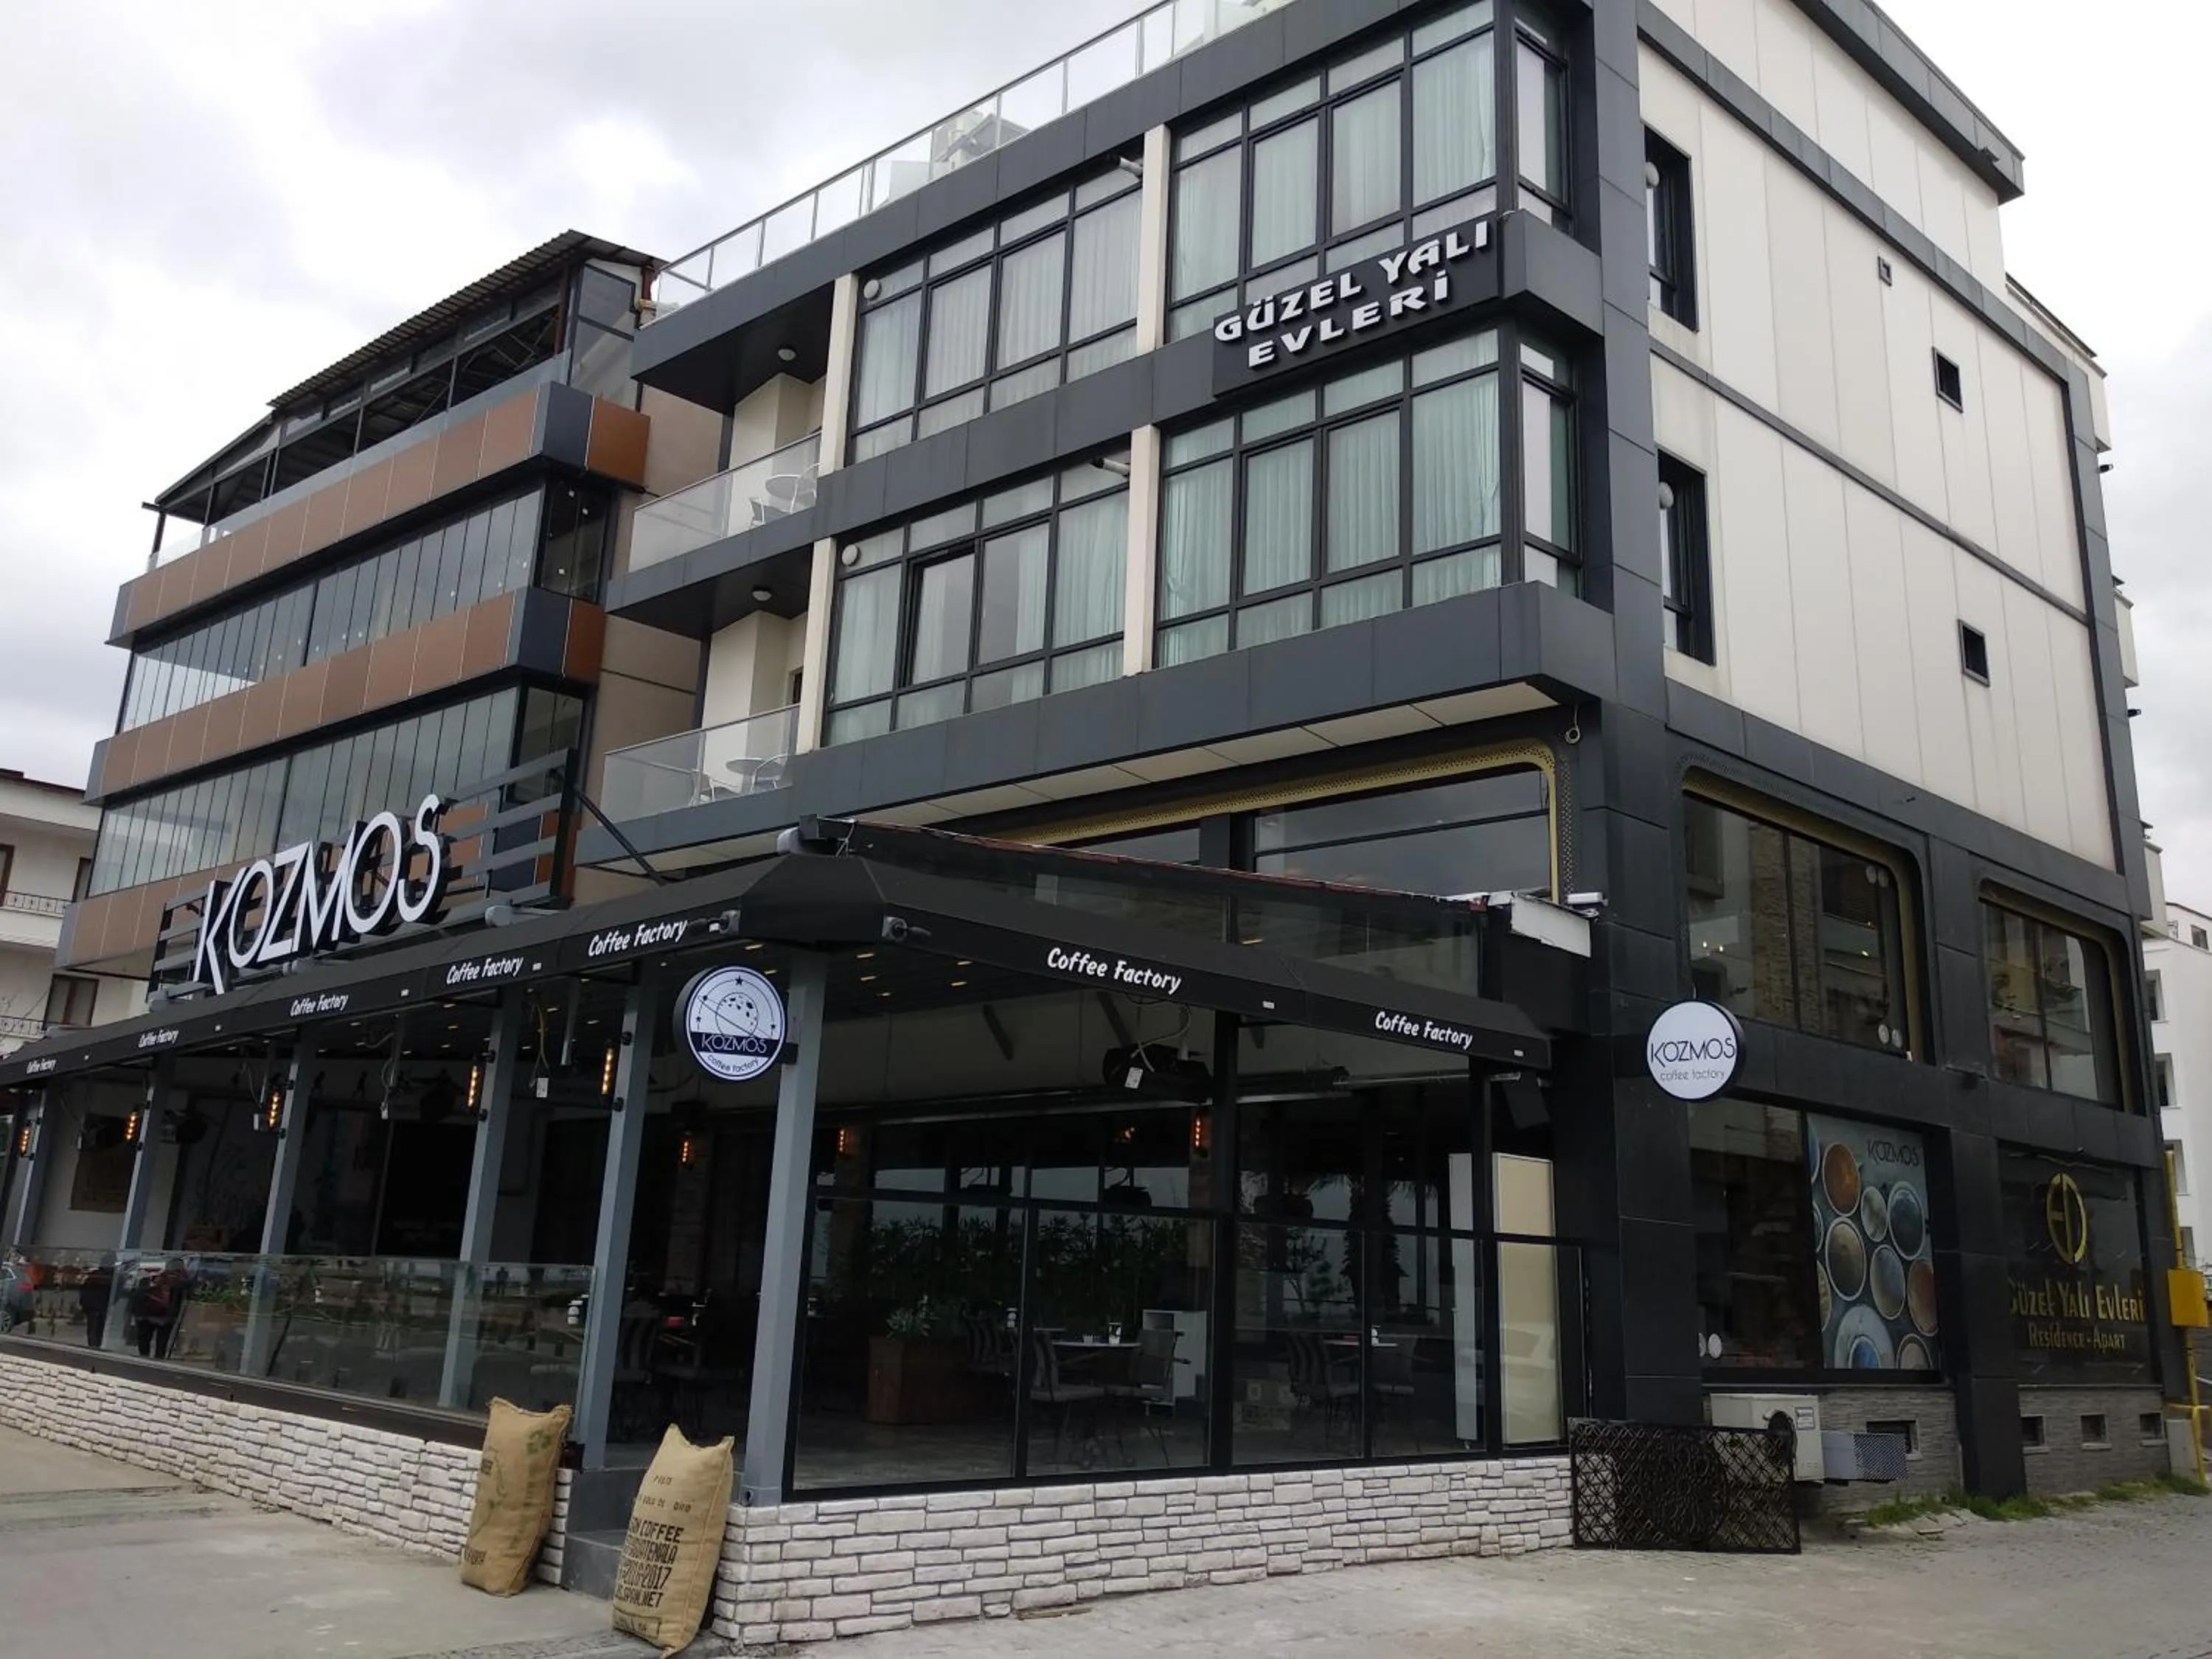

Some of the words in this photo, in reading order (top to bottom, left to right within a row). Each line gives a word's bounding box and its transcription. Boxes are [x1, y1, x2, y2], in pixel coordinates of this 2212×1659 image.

[1214, 272, 1363, 342] GÜZEL
[1379, 220, 1488, 285] YALI
[1248, 270, 1449, 368] EVLERİ
[192, 793, 442, 995] KOZMOS
[588, 930, 630, 957] Coffee
[634, 919, 688, 947] Factory
[446, 961, 480, 984] Coffee
[481, 957, 524, 978] Factory
[1047, 947, 1107, 977] Coffee
[1114, 960, 1181, 995] Factory
[290, 998, 316, 1017] Coffee
[317, 993, 349, 1012] Factory
[701, 1034, 767, 1054] KOZMOS
[1375, 1011, 1419, 1036] Coffee
[1423, 1020, 1472, 1050] Factory
[707, 1054, 731, 1071] coffee
[733, 1057, 759, 1073] factory
[1651, 1037, 1736, 1068] KOZMOS
[1660, 1069, 1689, 1082] coffee
[1692, 1068, 1725, 1081] factory
[1866, 1138, 1919, 1166] KOZMOS
[639, 1520, 685, 1543] COFFEE
